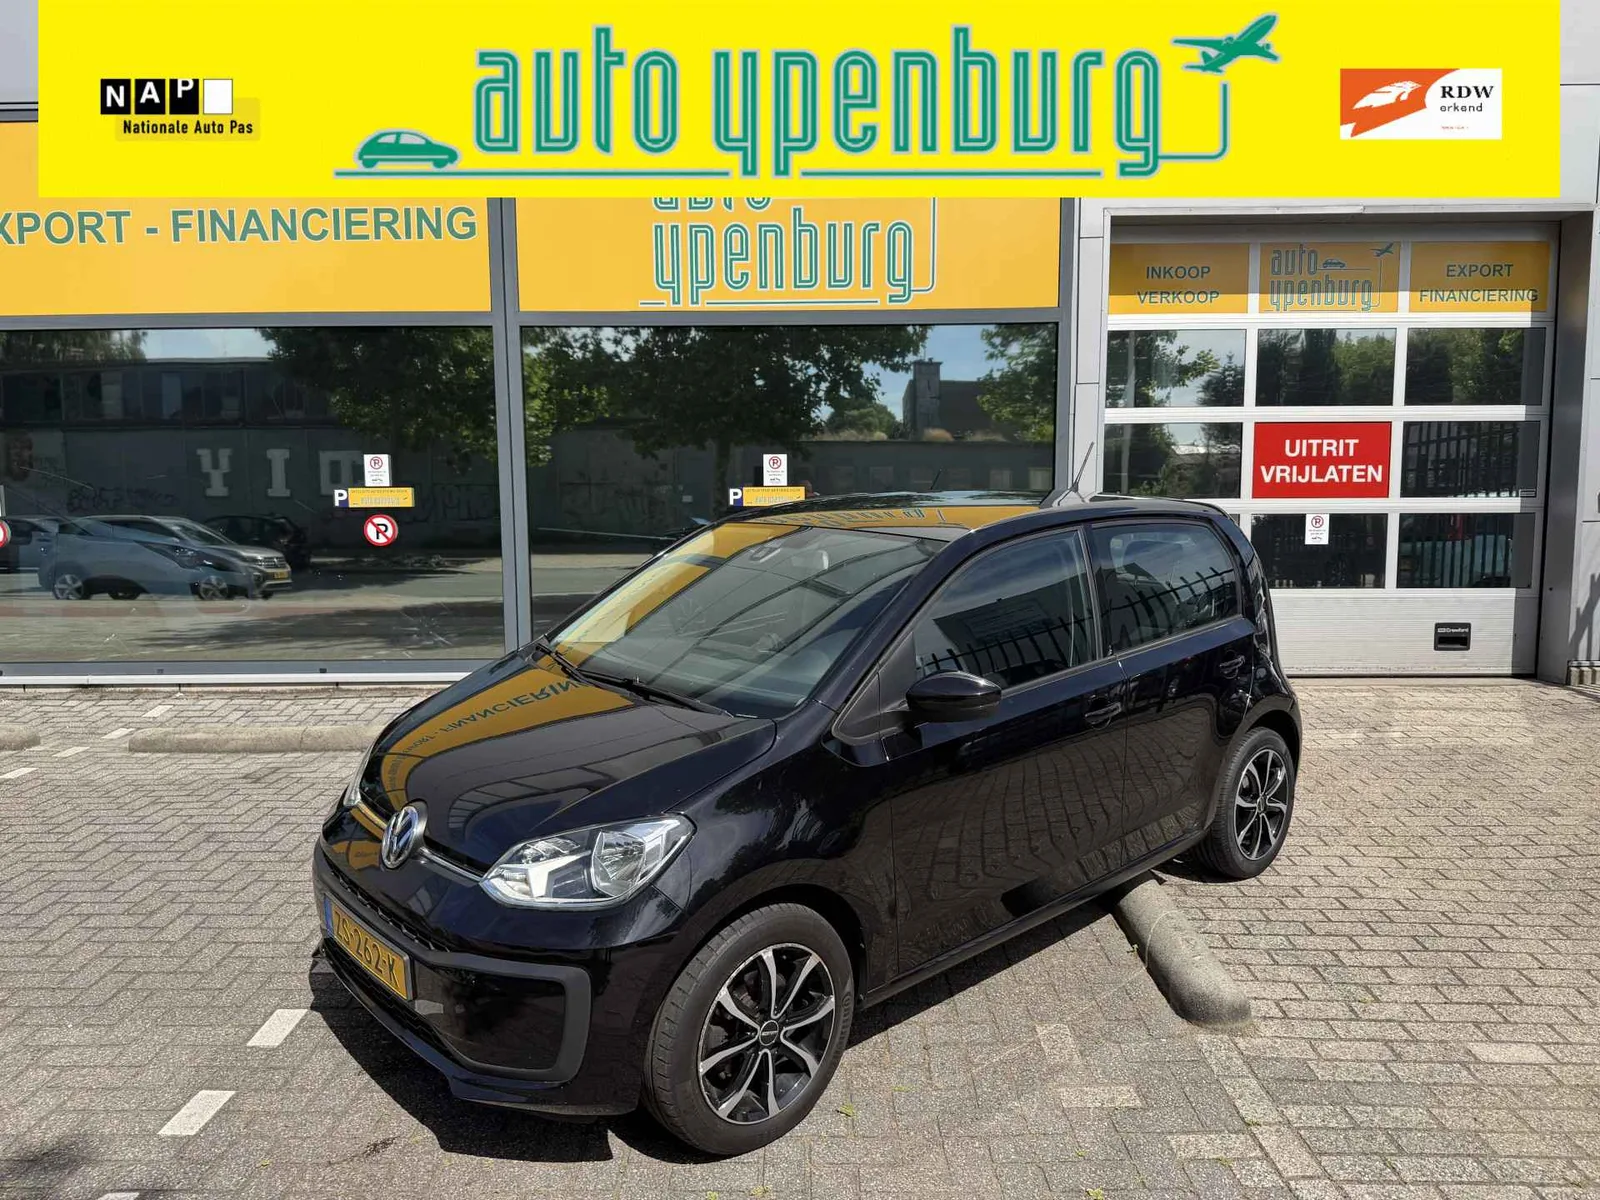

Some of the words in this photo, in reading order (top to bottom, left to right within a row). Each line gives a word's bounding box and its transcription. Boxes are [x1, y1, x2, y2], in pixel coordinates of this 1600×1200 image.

[171, 206, 478, 243] FINANCIERING
[652, 206, 913, 306] ypenburg
[1271, 243, 1318, 276] auto
[1146, 266, 1211, 279] INKOOP
[1446, 264, 1514, 277] EXPORT
[1137, 290, 1220, 304] VERKOOP
[1270, 274, 1373, 312] ypenburg
[1419, 288, 1539, 302] FINANCIERING
[1284, 439, 1359, 457] UITRIT
[1260, 465, 1383, 483] VRIJLATEN
